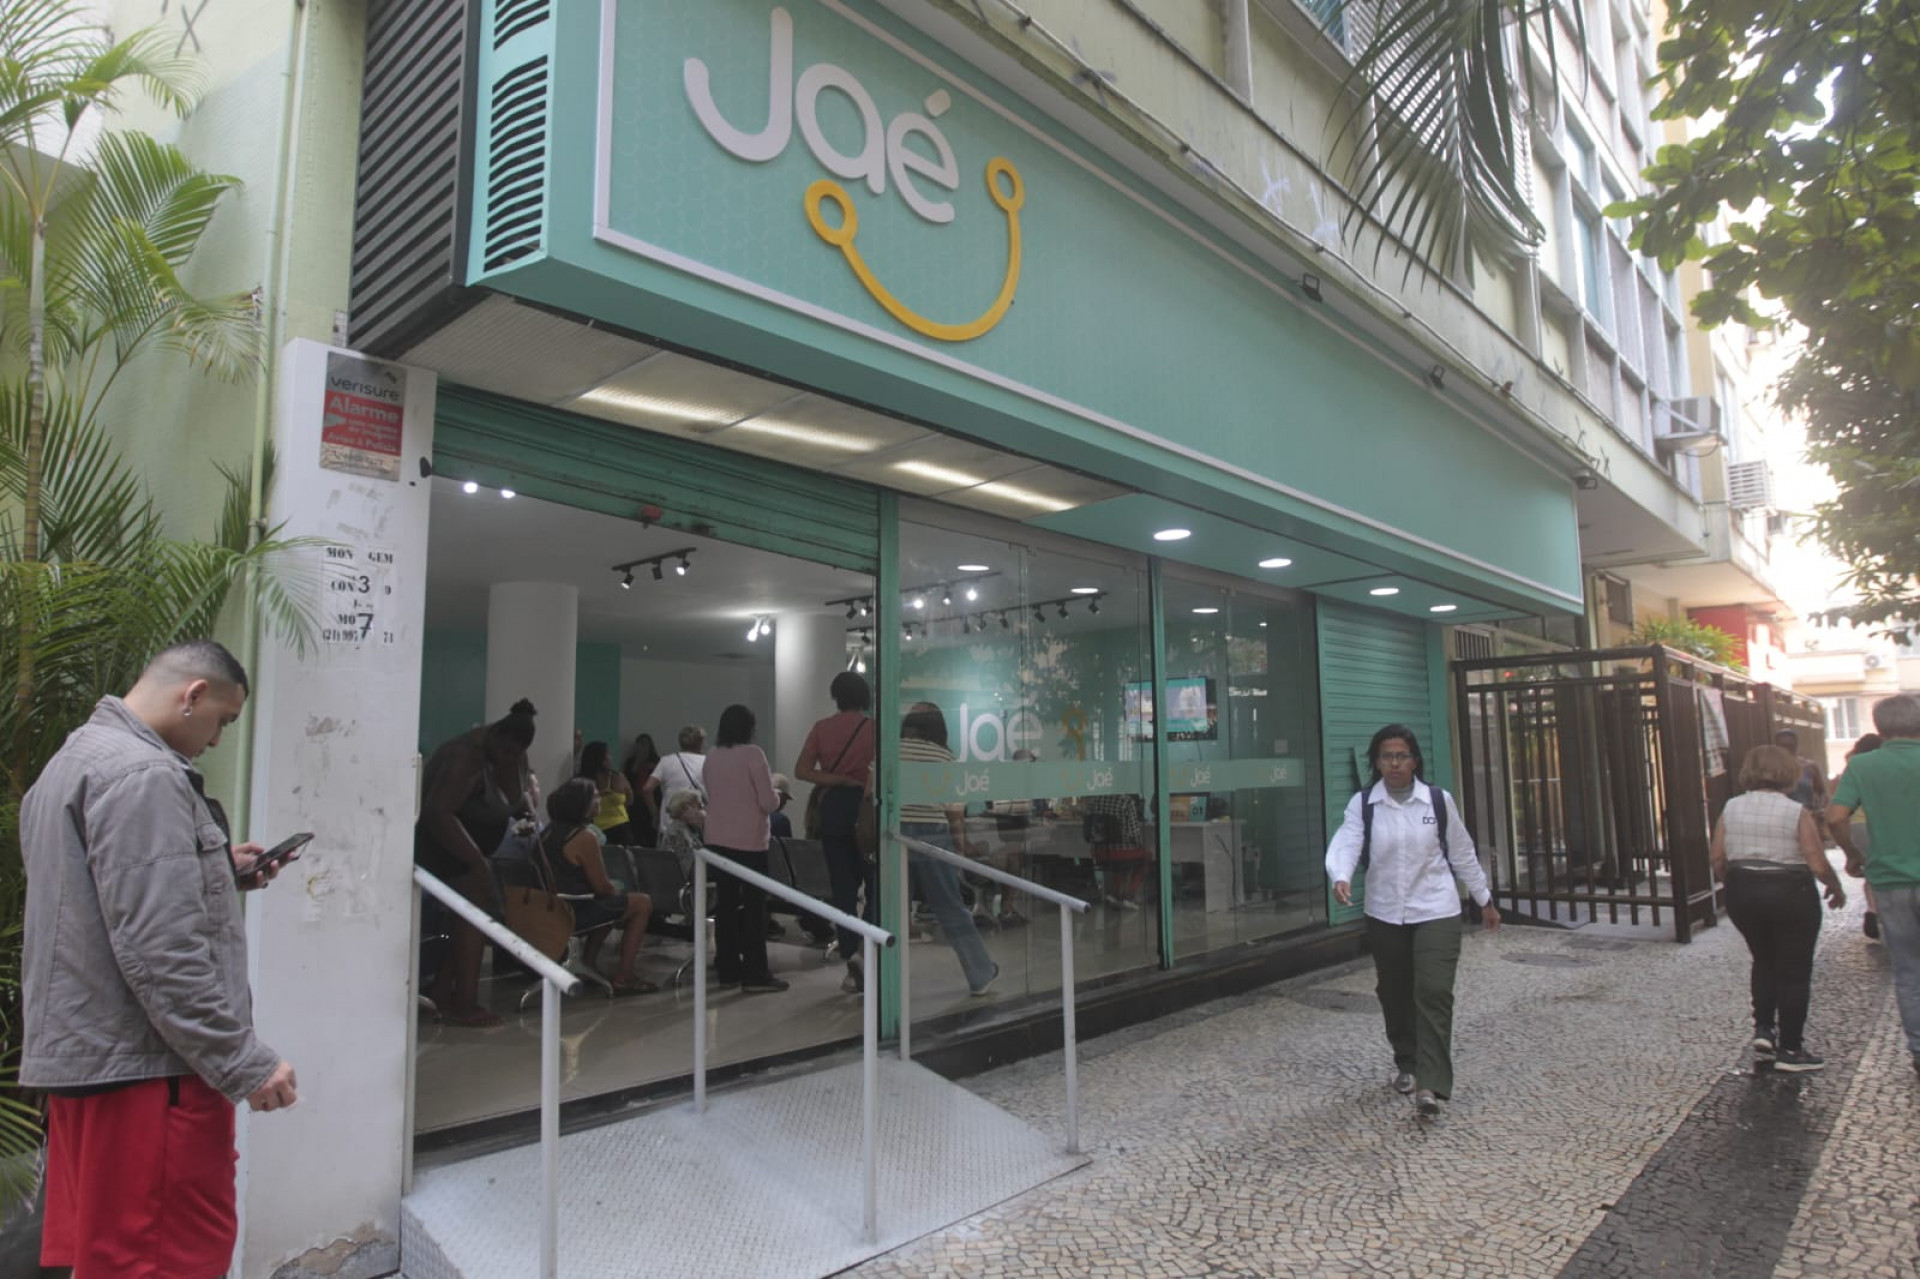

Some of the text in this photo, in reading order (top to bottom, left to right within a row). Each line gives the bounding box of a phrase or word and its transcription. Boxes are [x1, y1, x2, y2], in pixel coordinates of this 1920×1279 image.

[683, 6, 959, 223] Jaé
[330, 375, 400, 401] verisure
[328, 395, 400, 423] Alarme
[357, 575, 371, 594] 3
[357, 612, 375, 640] 7
